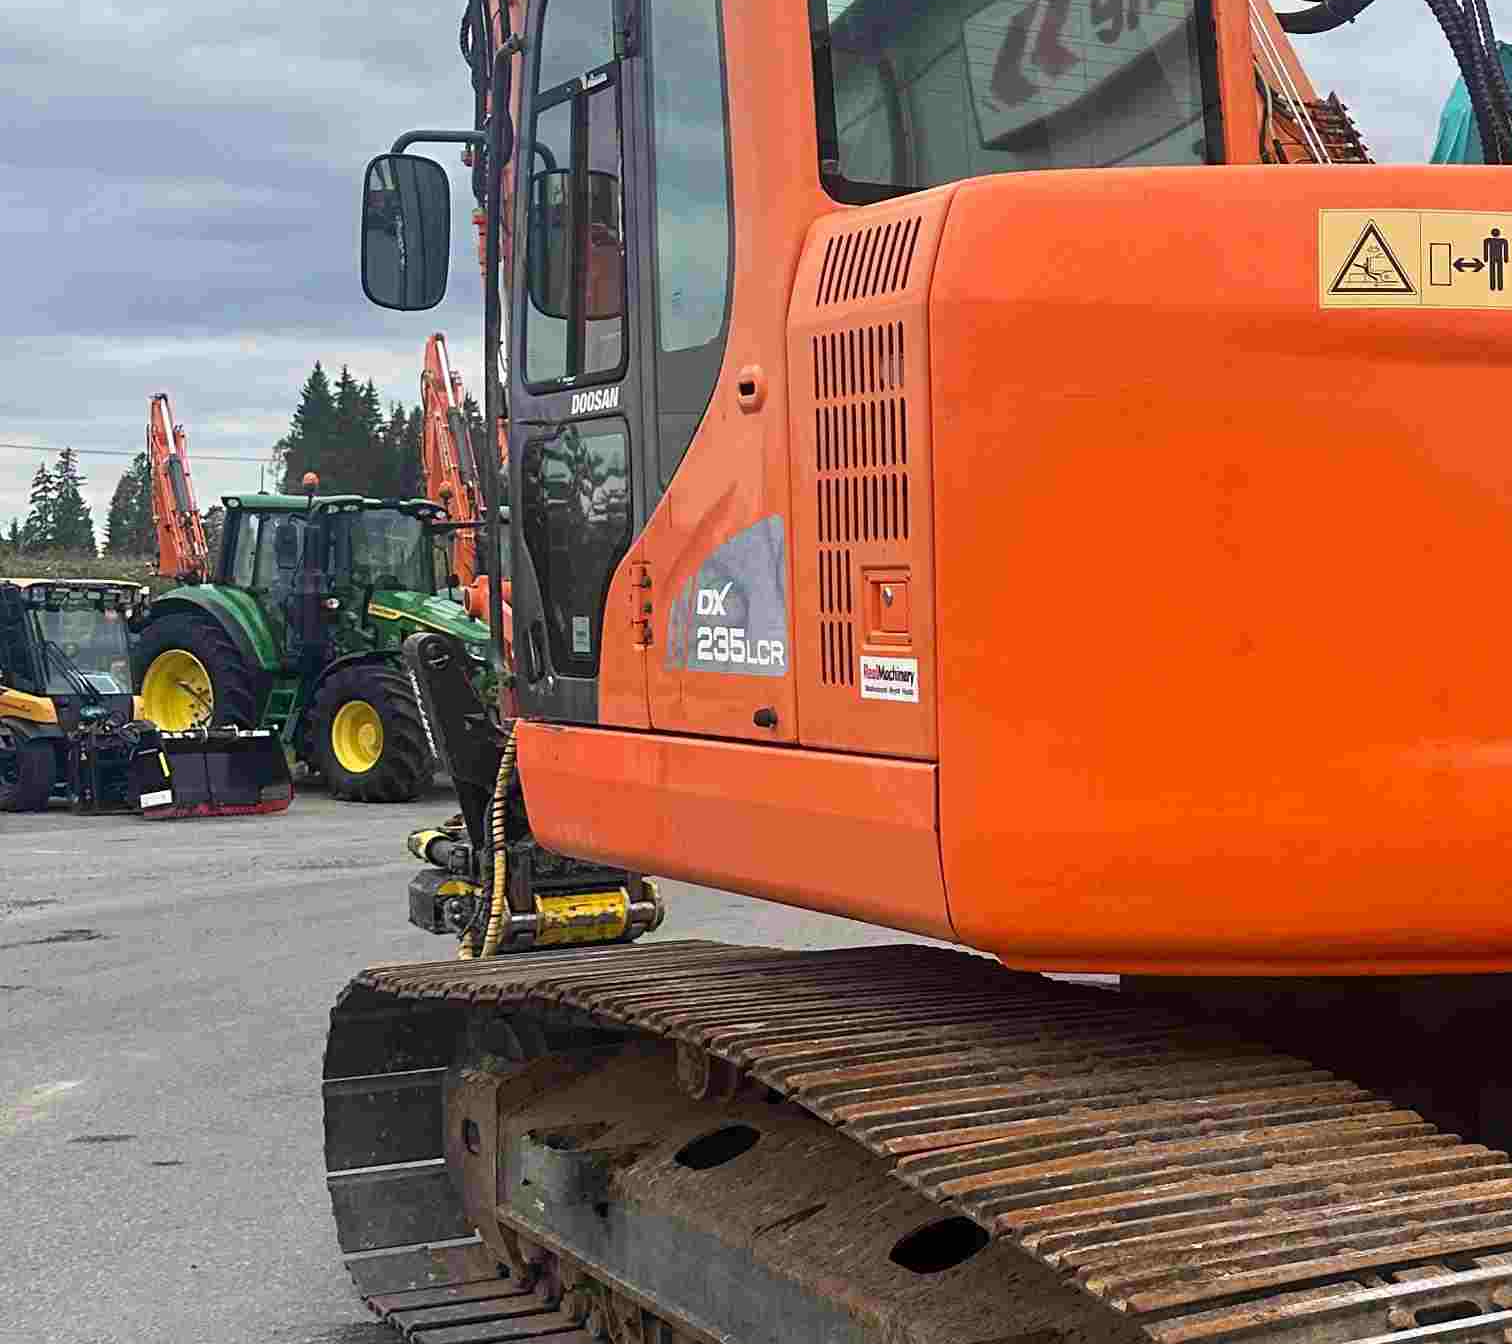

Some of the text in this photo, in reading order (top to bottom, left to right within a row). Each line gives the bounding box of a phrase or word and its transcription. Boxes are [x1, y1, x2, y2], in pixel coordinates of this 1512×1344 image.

[571, 386, 619, 415] DOOSAN
[696, 581, 733, 616] DX
[696, 626, 785, 666] 235LCR
